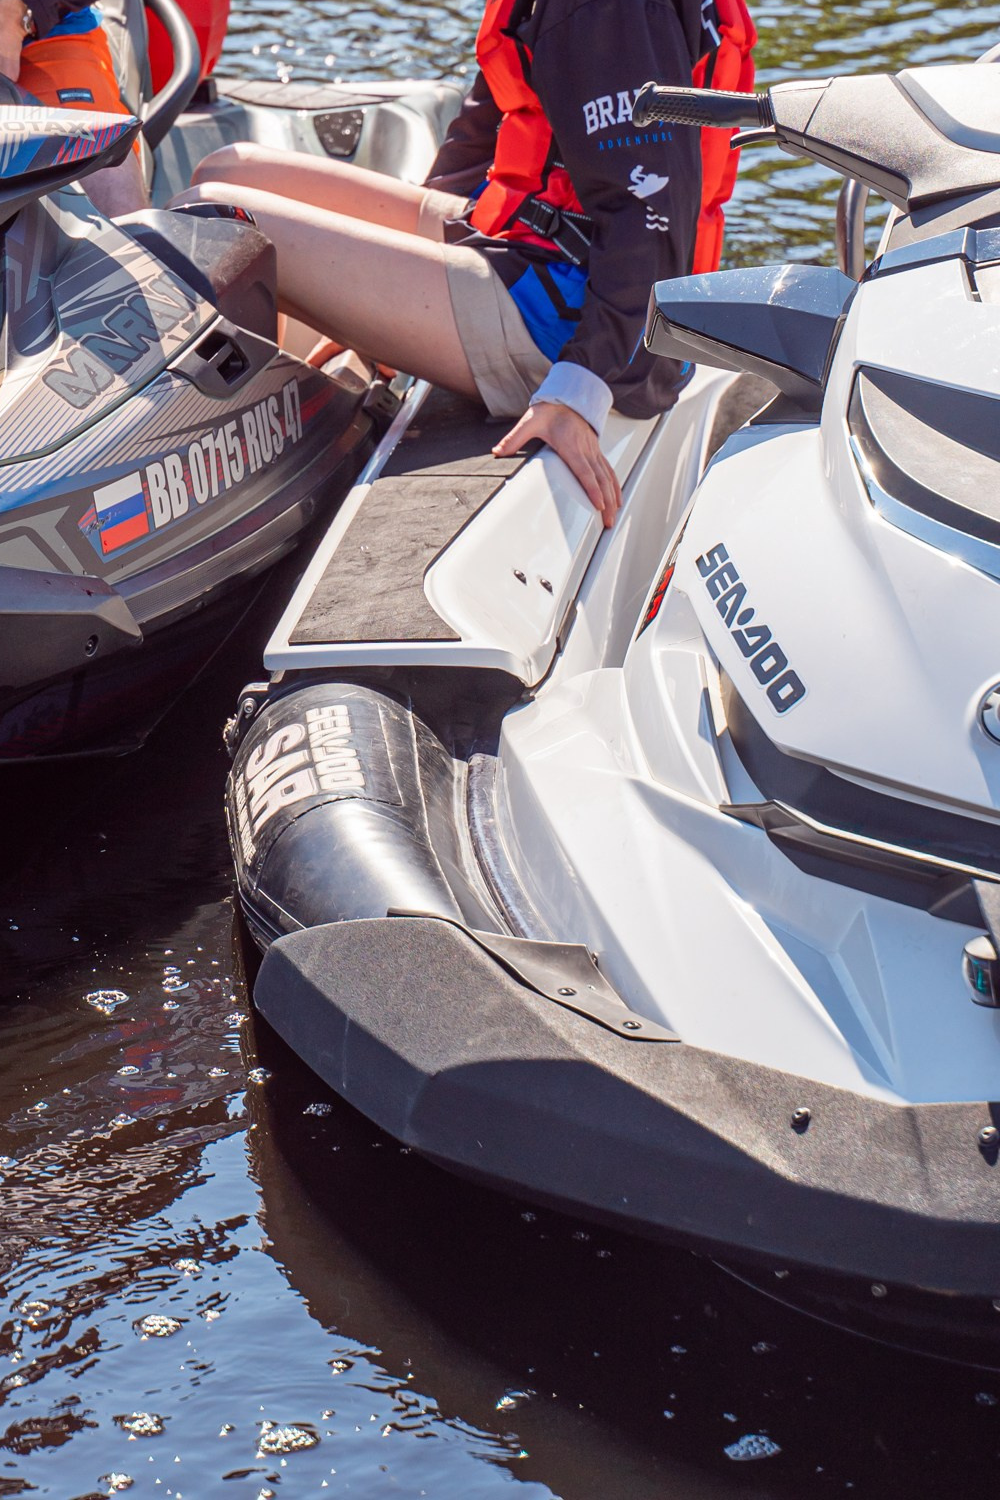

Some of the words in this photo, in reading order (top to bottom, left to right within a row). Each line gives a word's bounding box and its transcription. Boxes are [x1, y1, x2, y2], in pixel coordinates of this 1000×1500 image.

[145, 452, 190, 530] BB
[187, 419, 246, 505] 0715
[241, 395, 286, 475] RUS
[282, 377, 303, 445] 47
[244, 723, 320, 836] SAR
